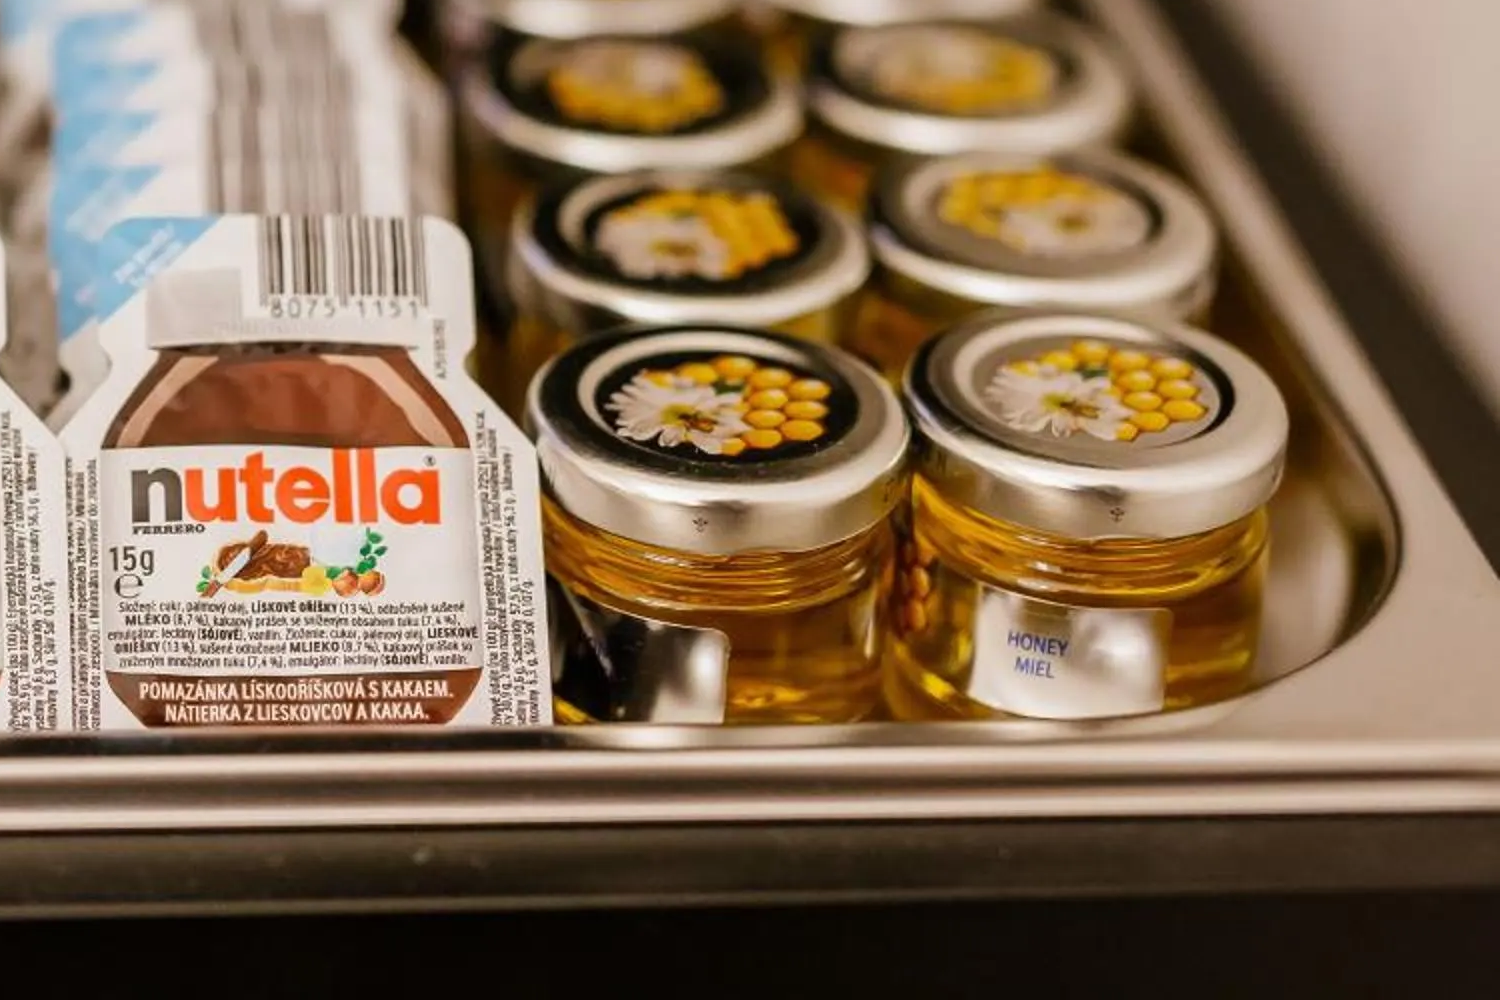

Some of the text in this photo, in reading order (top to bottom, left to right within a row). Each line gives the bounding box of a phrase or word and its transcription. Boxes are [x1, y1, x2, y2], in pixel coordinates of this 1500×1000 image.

[271, 298, 418, 319] 8075 1151
[131, 447, 441, 525] nutella
[132, 523, 205, 535] FERRERO
[110, 546, 154, 575] 15g
[125, 612, 170, 626] MLÉKO
[289, 641, 339, 653] MLIEKO
[1007, 630, 1069, 657] HONEY
[1014, 656, 1055, 679] MIEL
[139, 676, 454, 701] POMAZÁNKA LÍSKOOŘÍŠKOVÁ S KAKAEM.
[165, 700, 429, 722] NÁTIERKA Z LIESKOVCOV A KAKAA.
